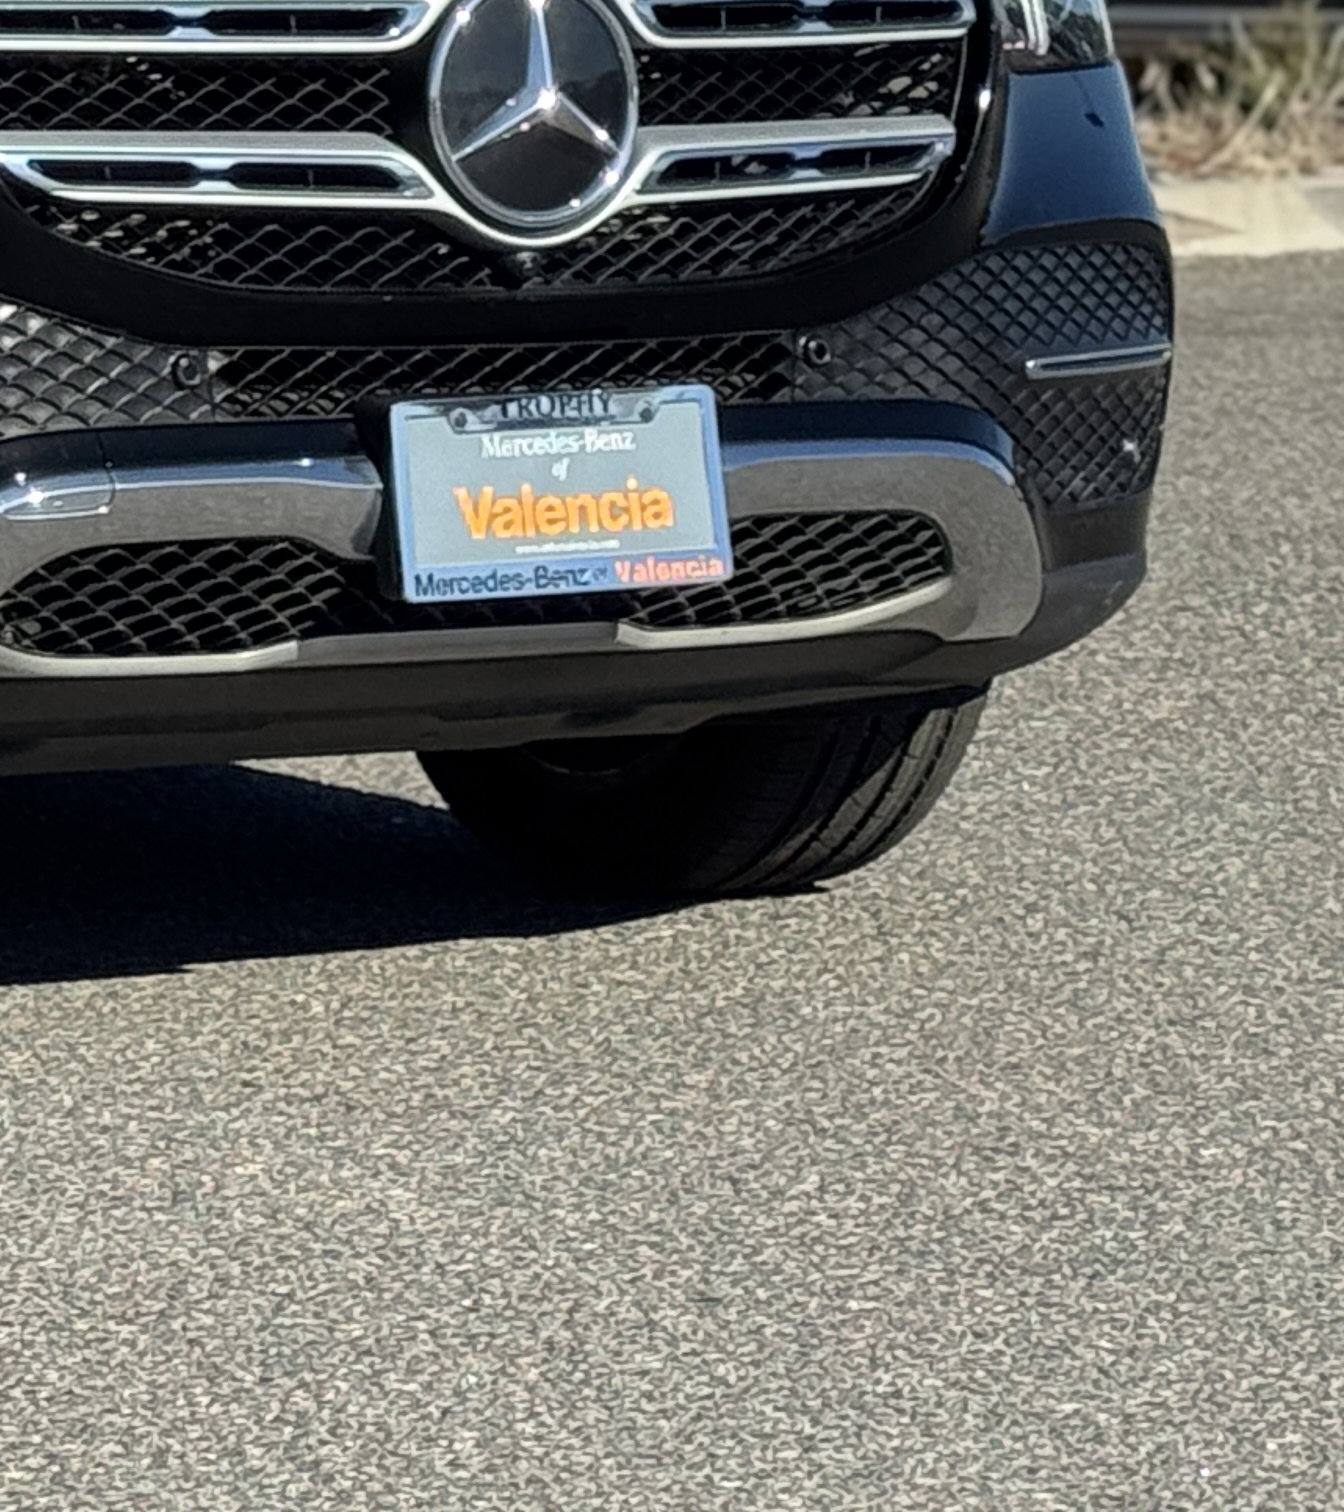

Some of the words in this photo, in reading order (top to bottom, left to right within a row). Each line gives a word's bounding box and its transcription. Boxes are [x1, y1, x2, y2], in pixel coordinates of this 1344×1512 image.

[500, 390, 611, 419] TROPHY
[480, 427, 637, 459] Mercedes-Benz
[551, 457, 570, 481] of
[452, 475, 676, 540] Valencia
[414, 565, 591, 597] Mercedes-Benz
[614, 554, 724, 584] Valencia
